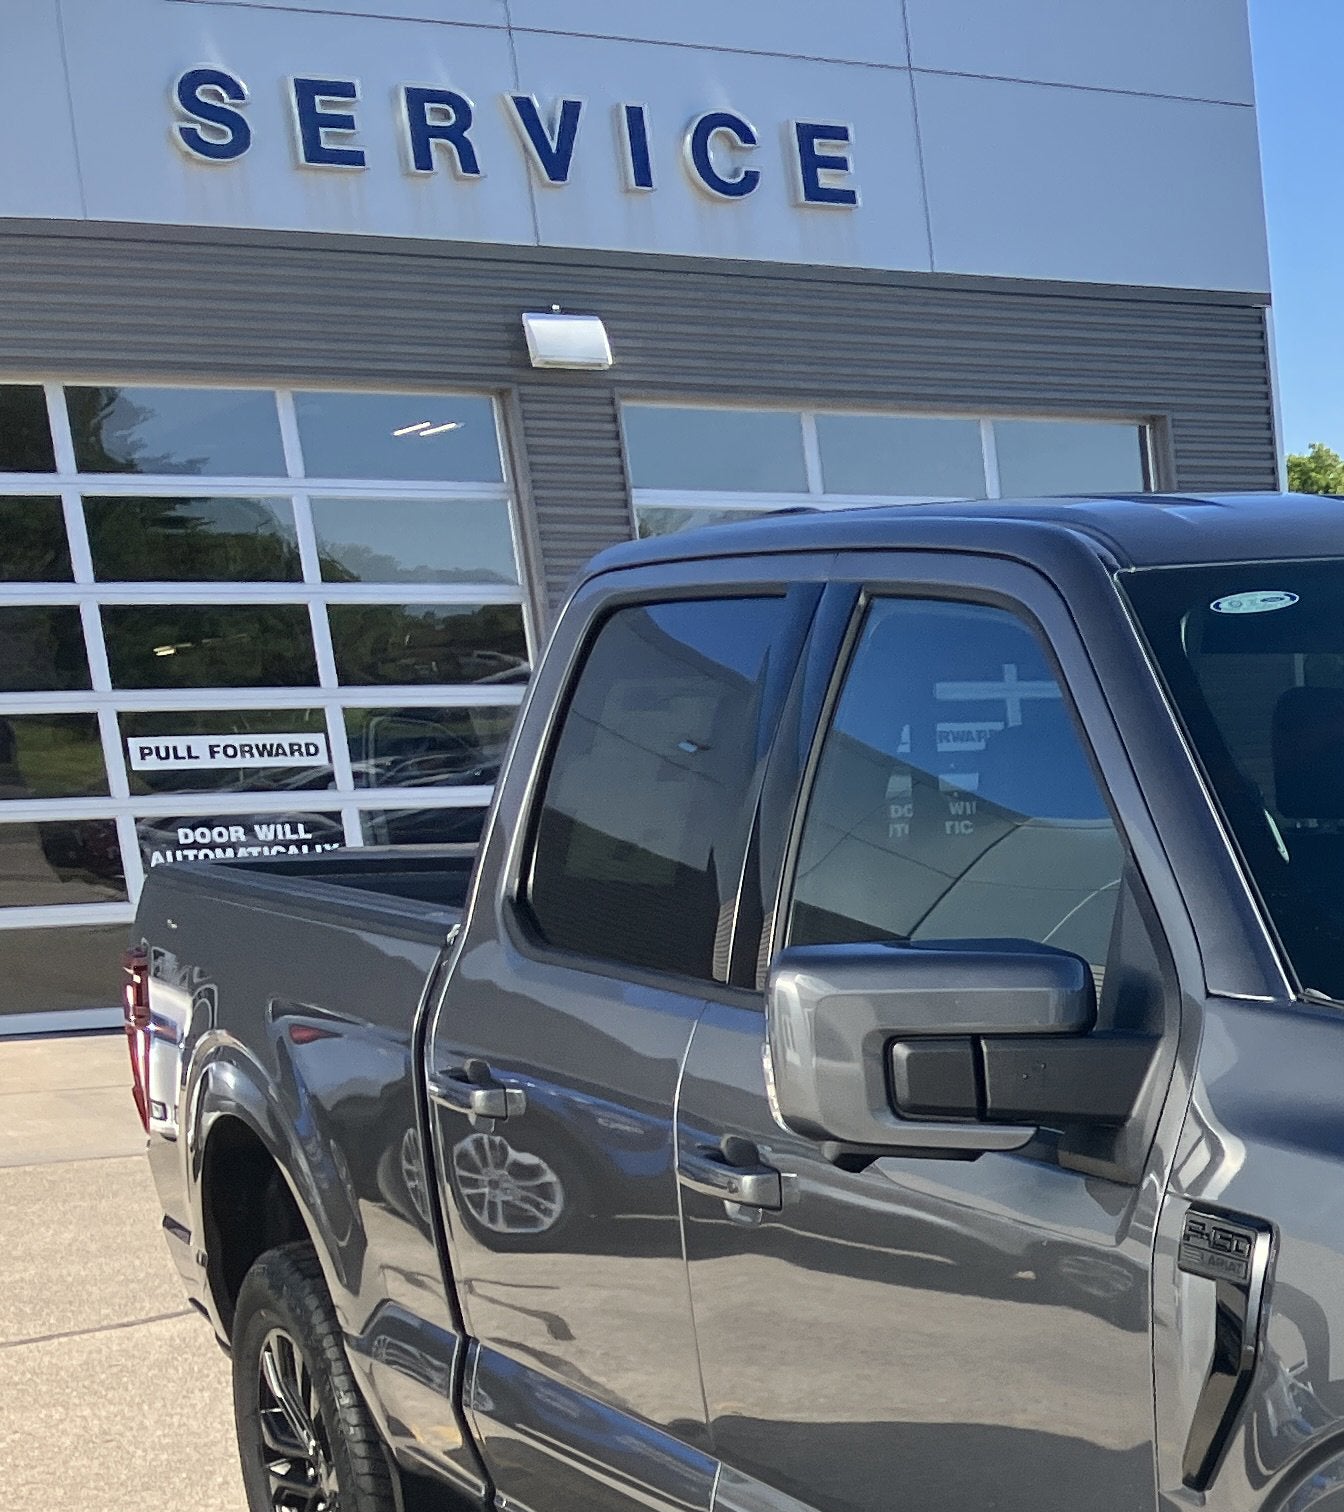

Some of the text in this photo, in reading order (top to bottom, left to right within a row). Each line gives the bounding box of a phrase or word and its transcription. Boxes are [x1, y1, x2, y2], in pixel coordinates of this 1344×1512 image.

[174, 67, 859, 207] SERVICE
[139, 742, 320, 760] PULL FORWARD
[177, 824, 312, 844] DOOR WILL
